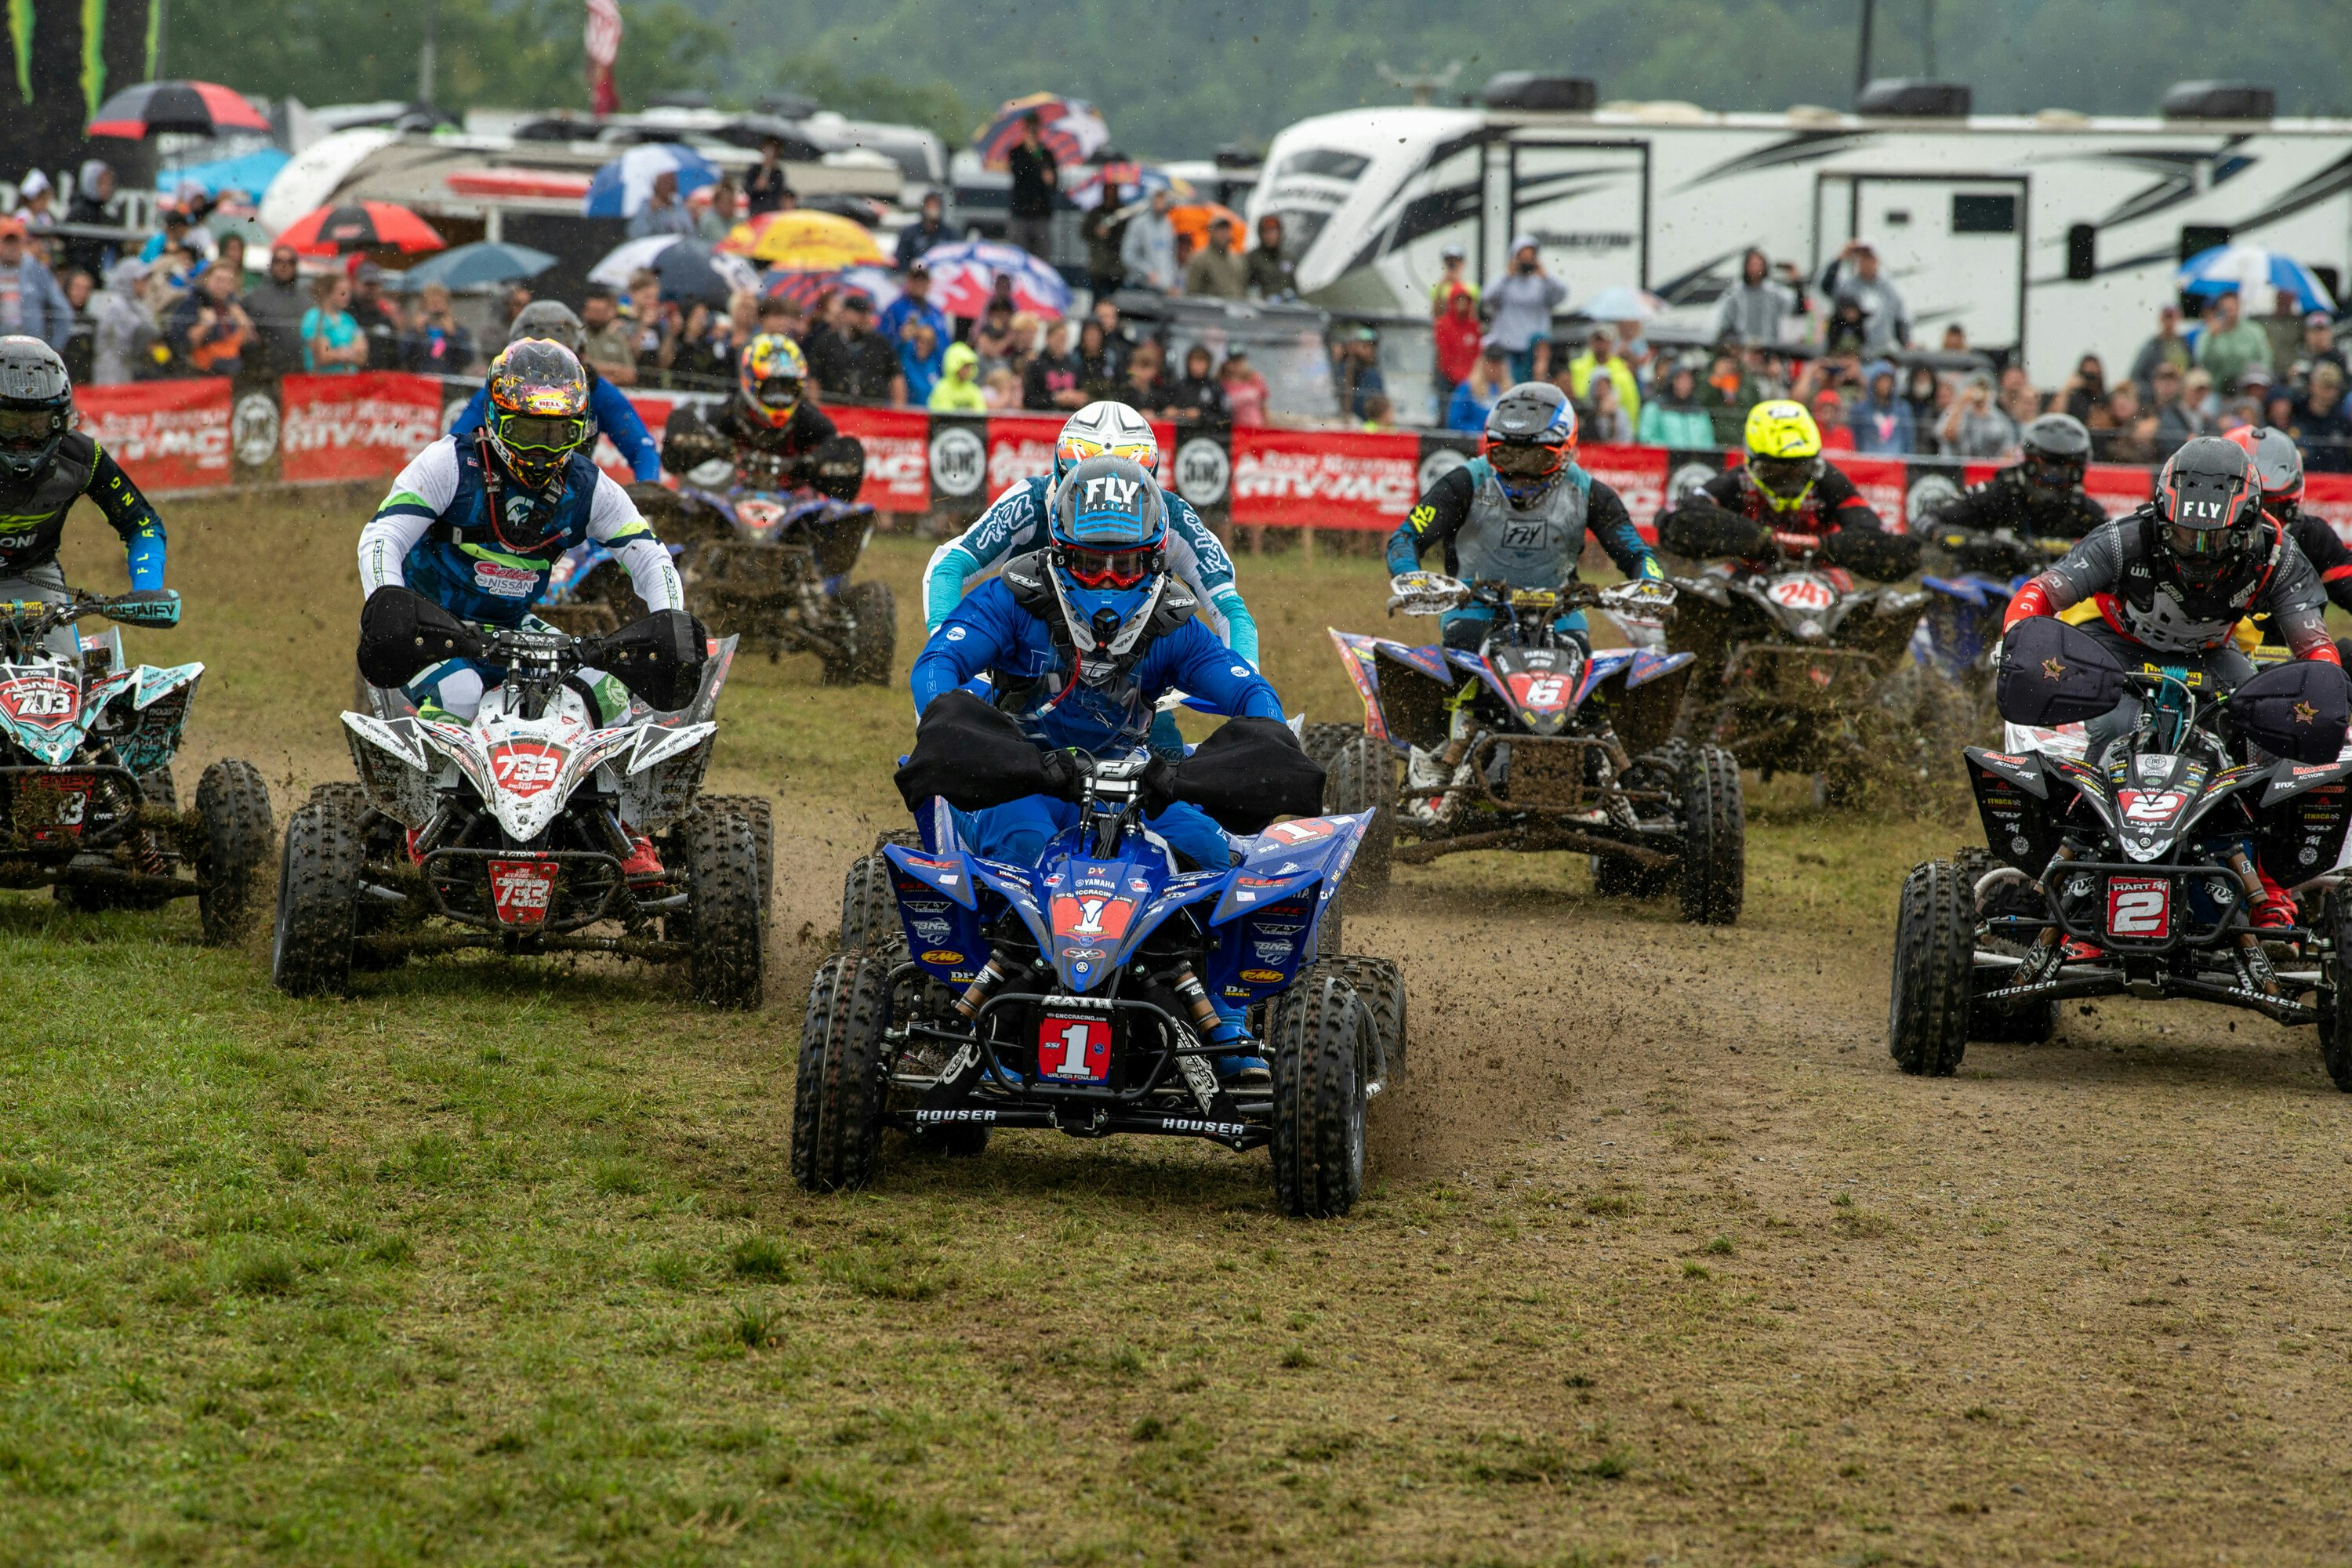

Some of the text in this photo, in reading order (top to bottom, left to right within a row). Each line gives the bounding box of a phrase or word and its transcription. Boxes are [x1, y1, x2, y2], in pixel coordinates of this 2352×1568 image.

[1087, 477, 1139, 506] FLY
[2183, 502, 2221, 518] FLY
[1509, 527, 1541, 544] FLY
[488, 579, 532, 591] NISSAN
[1526, 679, 1563, 704] 6
[13, 690, 71, 715] 703
[497, 753, 558, 782] 733
[2293, 762, 2341, 775] MAXXIS
[2126, 794, 2179, 819] 2
[94, 812, 112, 821] ONE
[1273, 822, 1319, 840] 1
[998, 869, 1033, 887] YAMALUBE
[1084, 879, 1116, 889] YAMAHA
[1163, 881, 1197, 892] YAMALUBE
[496, 877, 550, 907] 733
[2205, 882, 2234, 904] FOX
[1073, 899, 1104, 931] 1
[2113, 891, 2165, 932] 2
[917, 921, 950, 931] BNR
[1258, 942, 1293, 951] BNR
[921, 951, 964, 962] FMF
[1240, 971, 1284, 981] FMF
[1987, 980, 2058, 998] HOUSER
[2227, 985, 2303, 1009] HOUSER
[1041, 995, 1113, 1010] RATH
[1054, 1013, 1107, 1022] GNCCRACING.COM
[1056, 1024, 1091, 1076] 1
[916, 1109, 996, 1121] HOUSER
[1163, 1118, 1244, 1134] HOUSER
